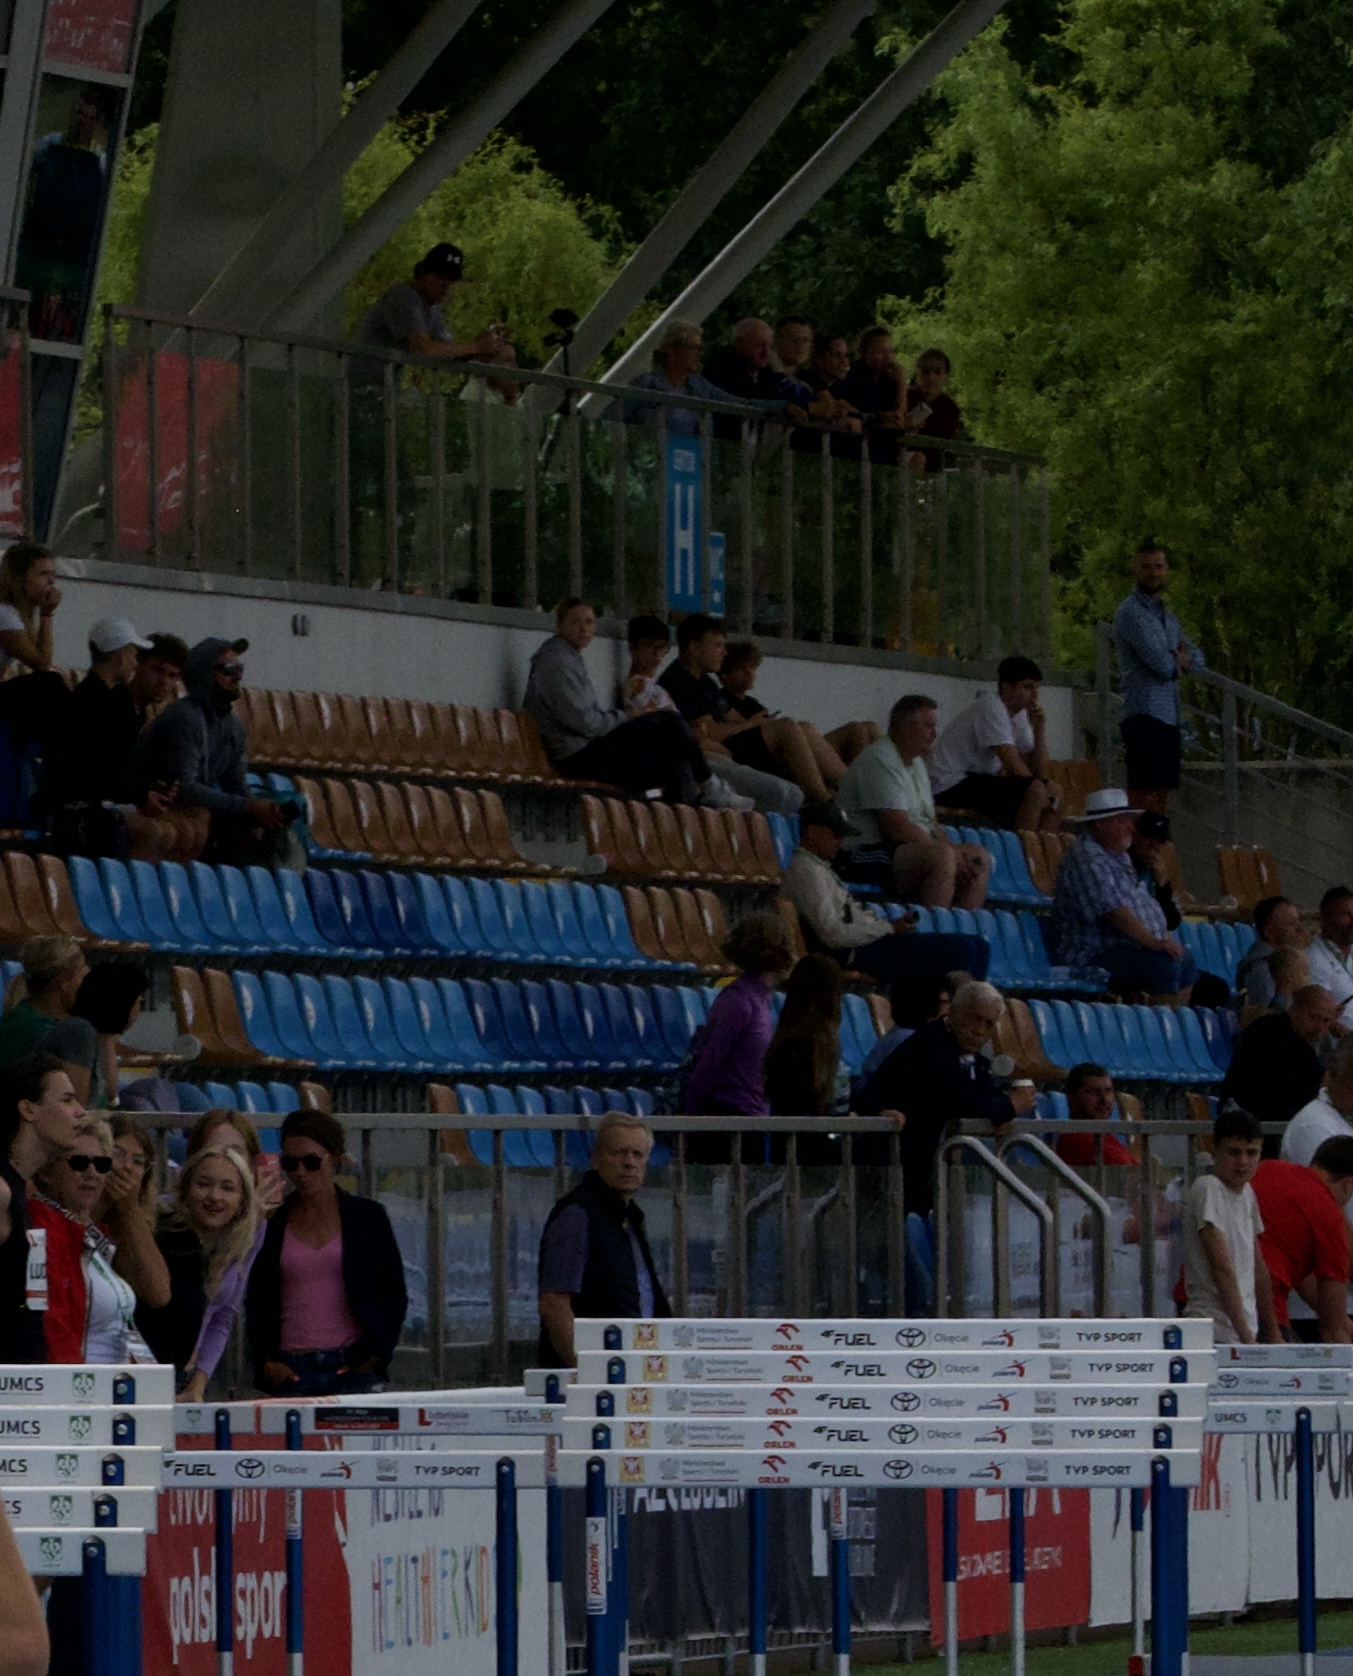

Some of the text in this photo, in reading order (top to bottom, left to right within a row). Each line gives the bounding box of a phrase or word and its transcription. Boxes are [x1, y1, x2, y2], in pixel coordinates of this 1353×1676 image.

[674, 482, 695, 596] H
[834, 1333, 877, 1346] FUEL
[1076, 1332, 1143, 1342] TVP SPORT
[844, 1364, 886, 1377] FUEL
[1088, 1362, 1155, 1374] TVP SPORT
[828, 1397, 871, 1410] FUEL
[1072, 1396, 1140, 1407] TVP SPORT
[1214, 1413, 1247, 1423] UMCS
[826, 1429, 869, 1442] FUEL
[1070, 1429, 1137, 1440] TVP SPORT
[174, 1463, 216, 1477] FUEL
[414, 1466, 480, 1477] TVP SPORT
[821, 1465, 864, 1478] FUEL
[1064, 1465, 1132, 1476] TVP SPORT
[589, 1542, 599, 1596] polanik
[234, 1571, 287, 1660] spor
